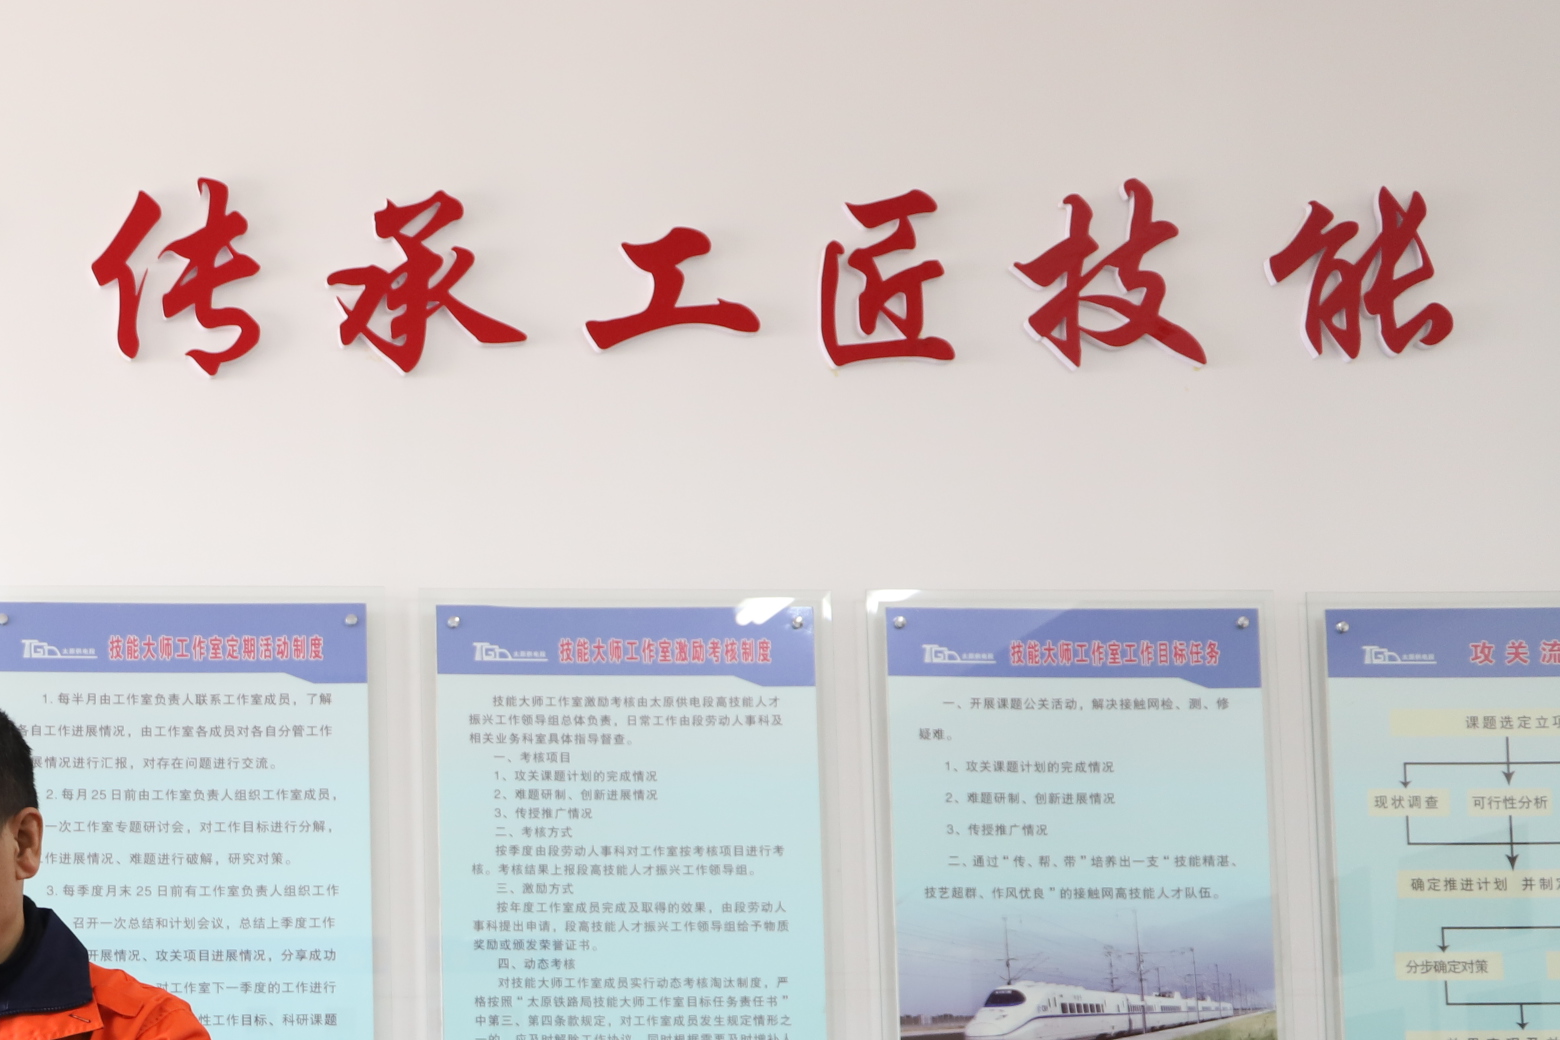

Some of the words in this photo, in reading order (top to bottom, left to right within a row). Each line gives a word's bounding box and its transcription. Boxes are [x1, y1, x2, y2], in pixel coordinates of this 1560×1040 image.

[92, 178, 1452, 375] 传承工匠技能
[108, 634, 324, 661] 技能大师工作室定期活动制度
[558, 637, 772, 664] 技能大师工作室激励考核制度
[1009, 639, 1220, 666] 技能大师工作室工作目标任务
[917, 727, 952, 741] 疑难。
[493, 751, 570, 764] 一、考核项目
[1374, 795, 1439, 809] 现状调查
[1472, 795, 1549, 810] 可行性分析
[494, 807, 593, 820] 3、传授推广情况
[495, 825, 573, 838] 二、考核方式
[946, 823, 1049, 837] 3、传授推广情况
[41, 852, 291, 866] 作进展情况、难题进行破解，研究对策。
[496, 882, 574, 895] 三、激励方式
[1410, 877, 1508, 892] 确定推进计划
[73, 916, 336, 930] 召开一次总结和计划会议，总结上季度工作
[473, 939, 597, 952] 奖励或颁发荣誉证书。
[497, 958, 575, 970] 四、动态考核
[1405, 959, 1489, 974] 分步确定对策
